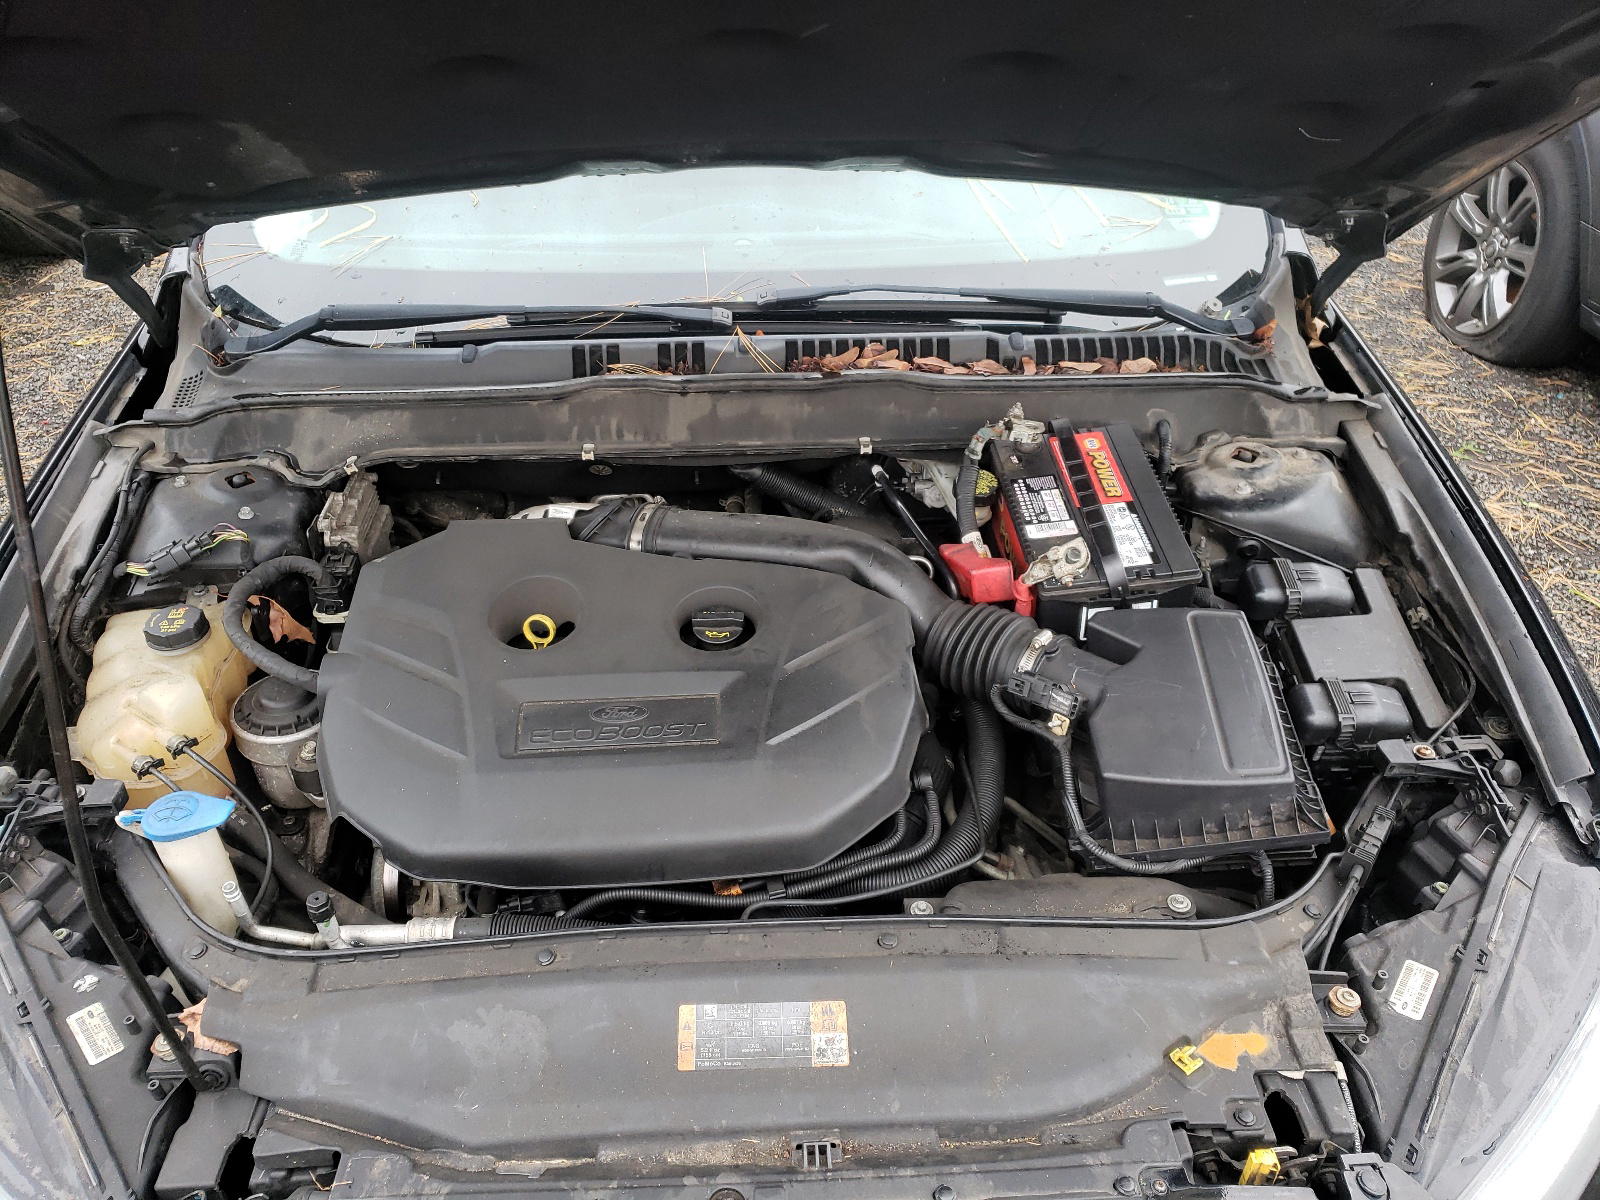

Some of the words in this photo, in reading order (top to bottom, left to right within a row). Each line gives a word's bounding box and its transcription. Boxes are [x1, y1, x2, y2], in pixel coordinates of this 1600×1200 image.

[1088, 451, 1122, 497] POWER
[602, 706, 638, 719] Ford
[530, 723, 707, 744] ECOBOOST
